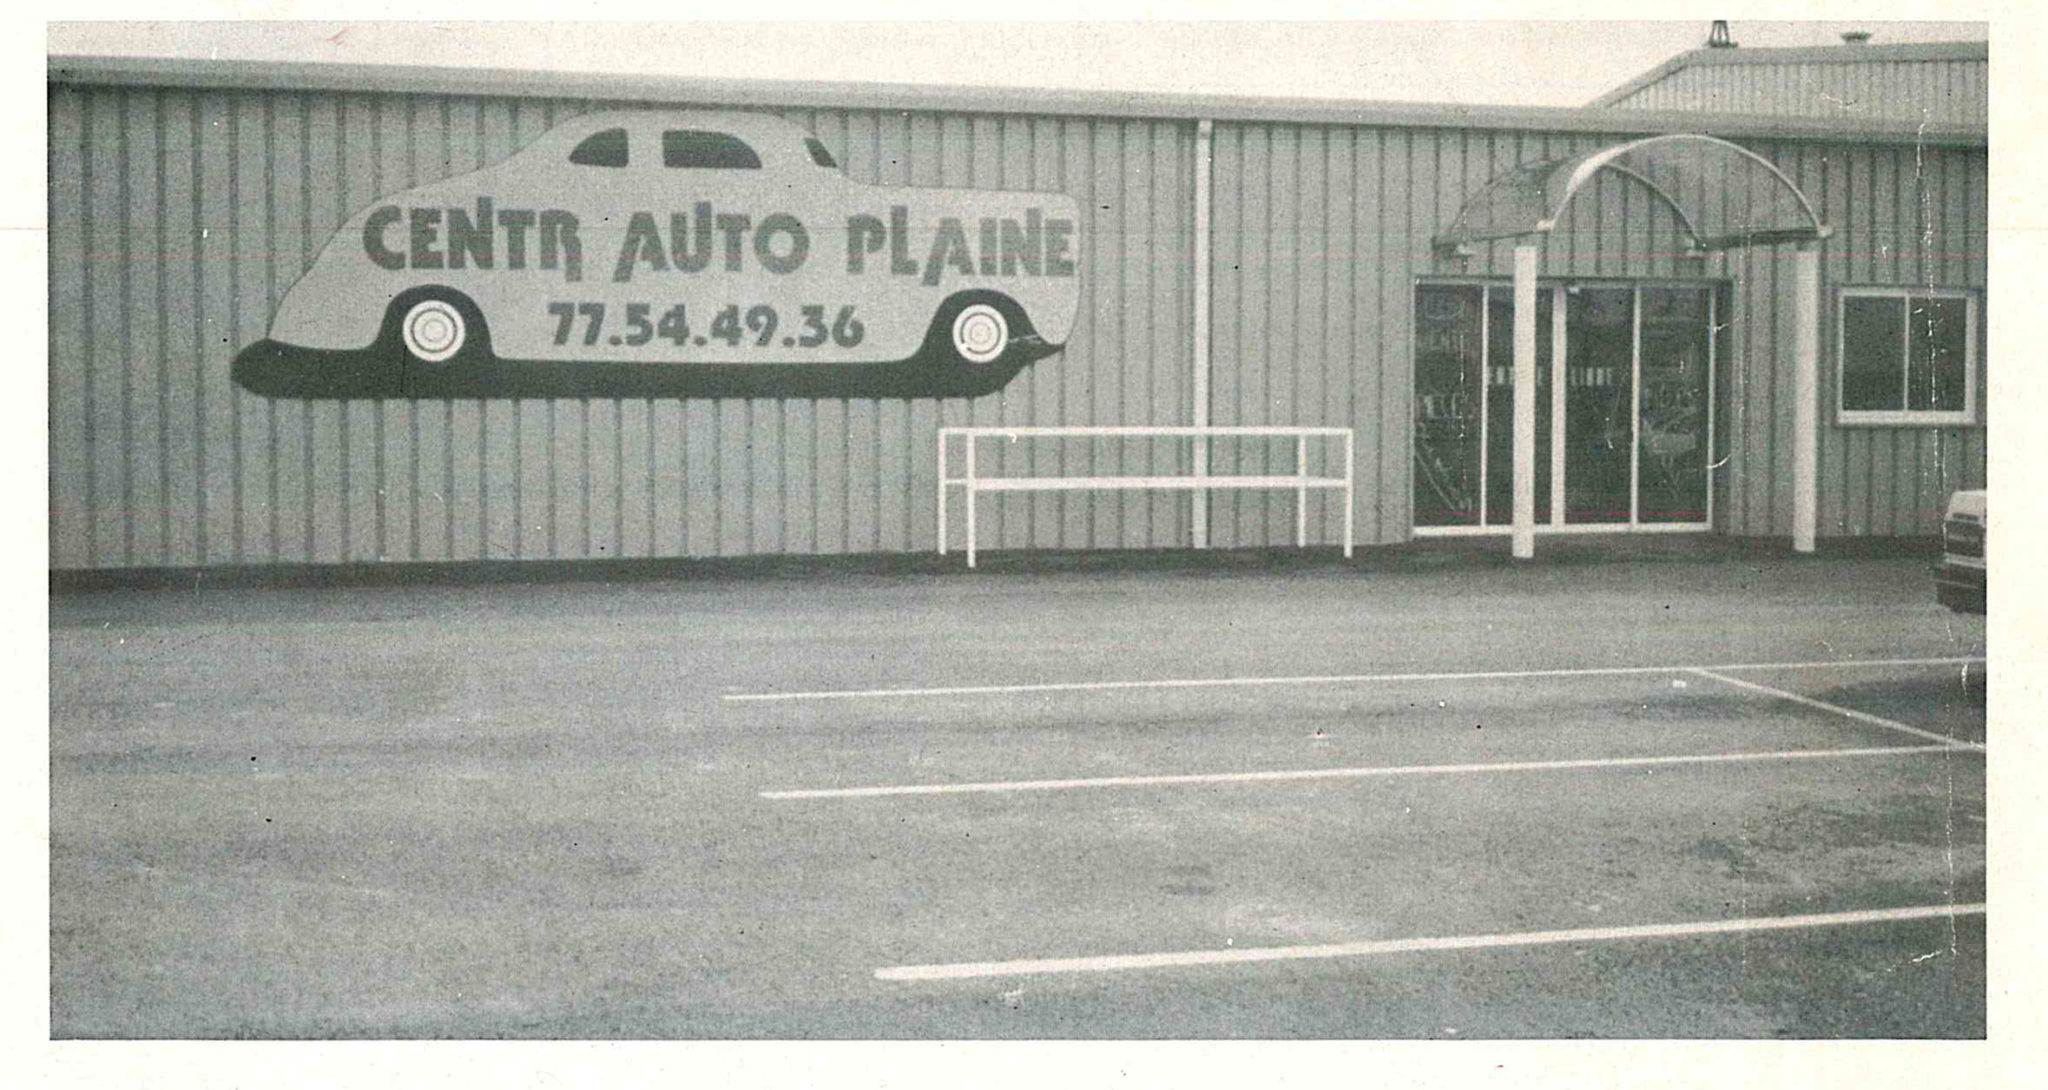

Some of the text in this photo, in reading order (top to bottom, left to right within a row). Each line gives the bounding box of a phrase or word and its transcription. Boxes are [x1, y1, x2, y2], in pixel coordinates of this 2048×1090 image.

[363, 197, 1075, 286] CENTR AUTO PLAINE
[548, 302, 865, 347] 77.54.49.36
